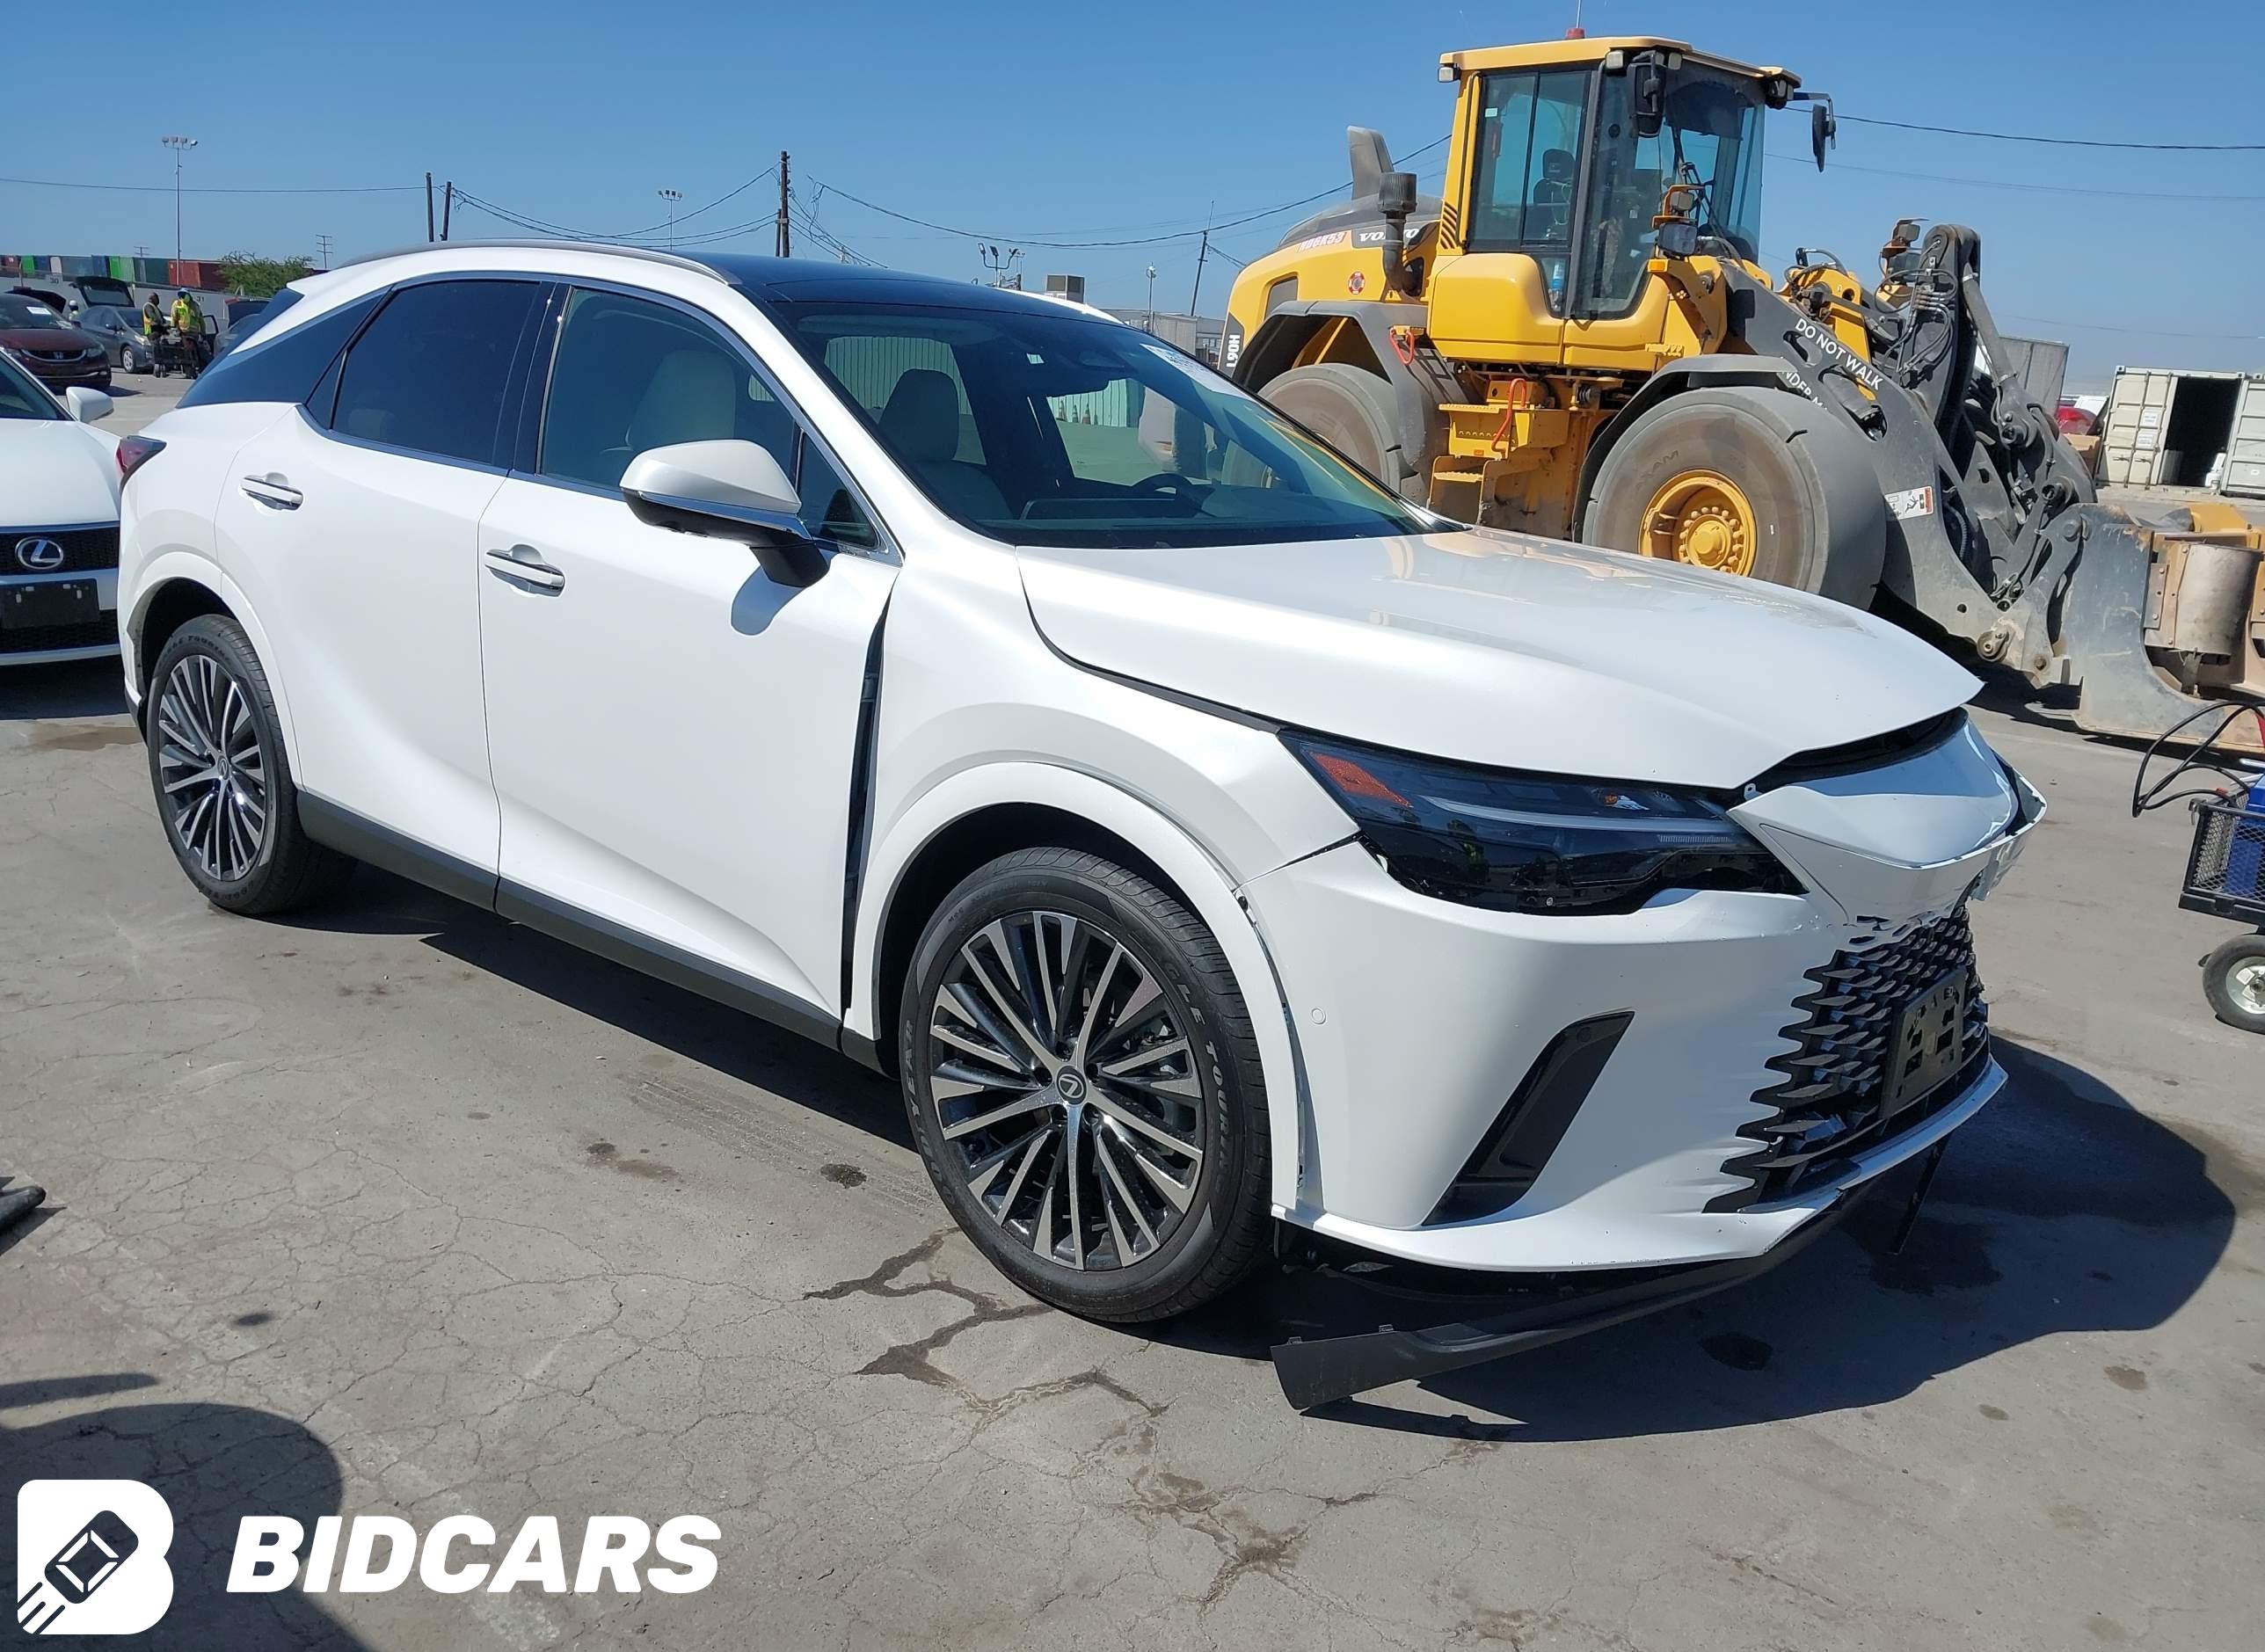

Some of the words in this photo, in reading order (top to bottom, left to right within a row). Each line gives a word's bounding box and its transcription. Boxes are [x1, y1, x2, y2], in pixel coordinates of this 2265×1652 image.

[1359, 229, 1420, 242] VOO
[1226, 334, 1241, 368] L90H
[1795, 318, 1816, 338] DO
[1816, 333, 1846, 360] NOT
[1846, 354, 1883, 390] WALK
